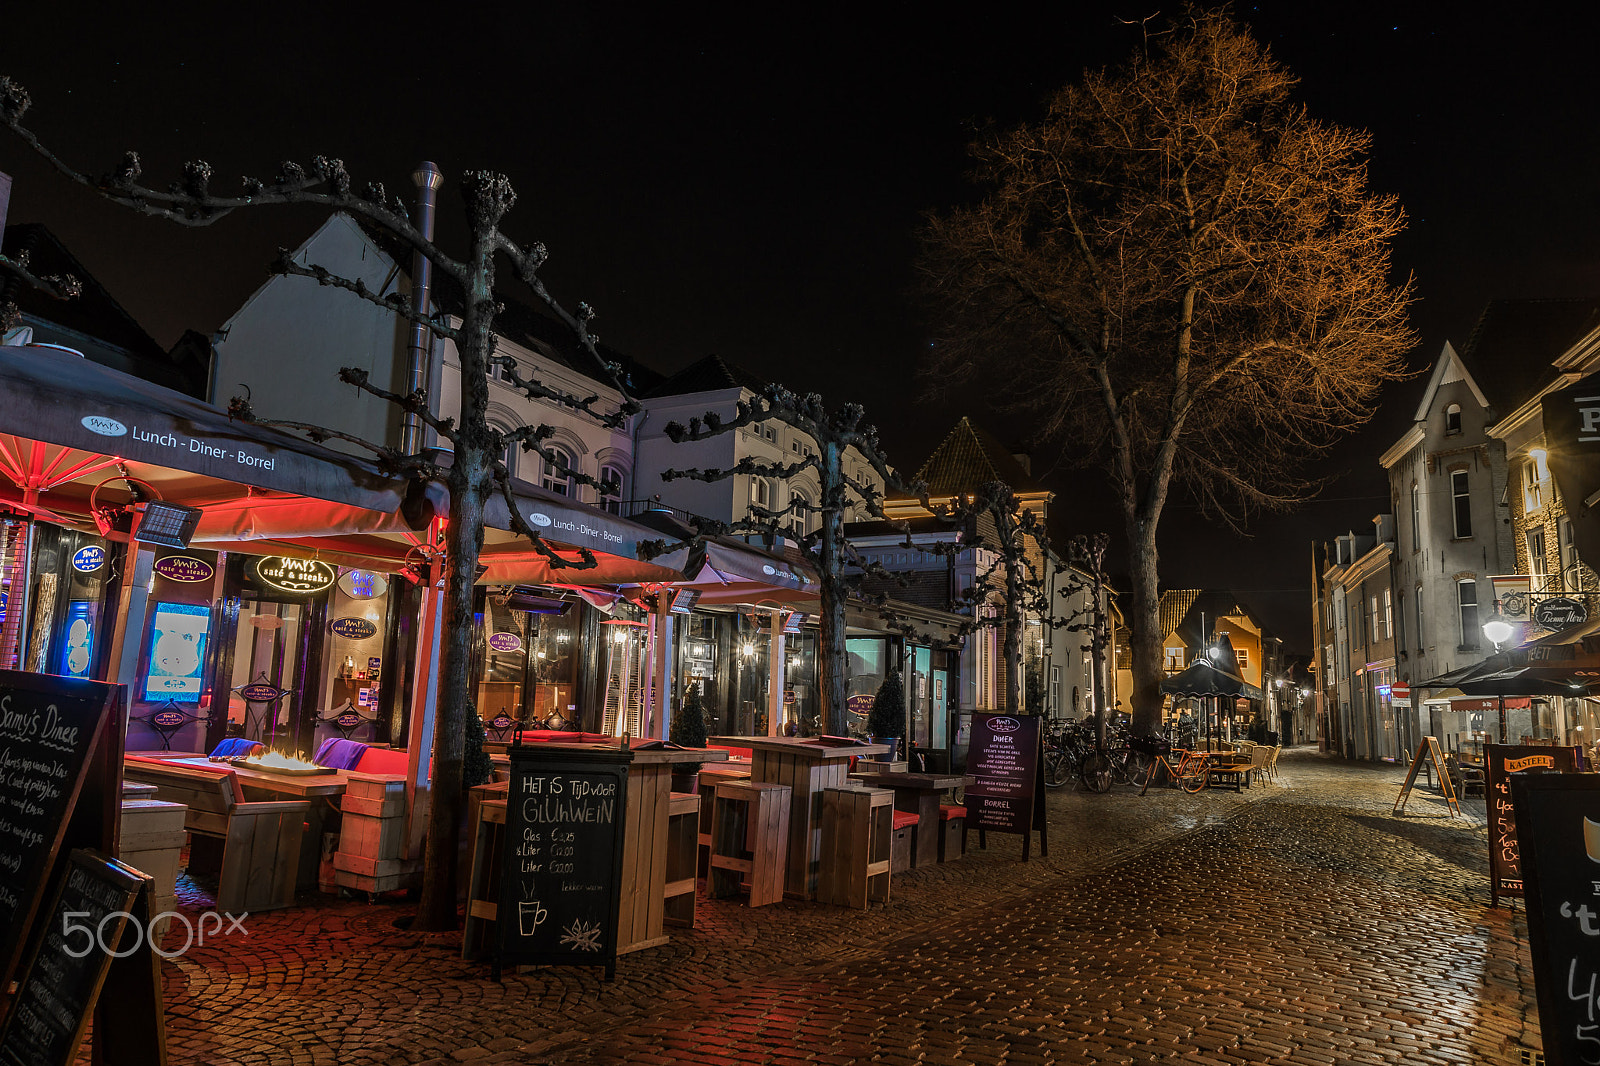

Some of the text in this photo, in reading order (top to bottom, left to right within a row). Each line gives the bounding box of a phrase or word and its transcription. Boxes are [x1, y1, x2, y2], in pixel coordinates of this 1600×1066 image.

[132, 426, 177, 448] Lunch
[189, 438, 227, 459] Diner
[237, 451, 275, 471] Borrel
[553, 518, 575, 531] Lunch
[580, 524, 599, 538] Diner
[603, 530, 623, 544] Borrel
[186, 568, 208, 577] steaks
[299, 572, 328, 583] steaks
[352, 586, 373, 597] OPEN
[0, 695, 41, 737] Samy's
[1509, 757, 1548, 770] KASTEEL
[522, 776, 546, 794] HET
[984, 799, 1010, 809] BORREL
[523, 827, 541, 844] Glas
[522, 841, 541, 857] Liter
[521, 859, 543, 873] Liter
